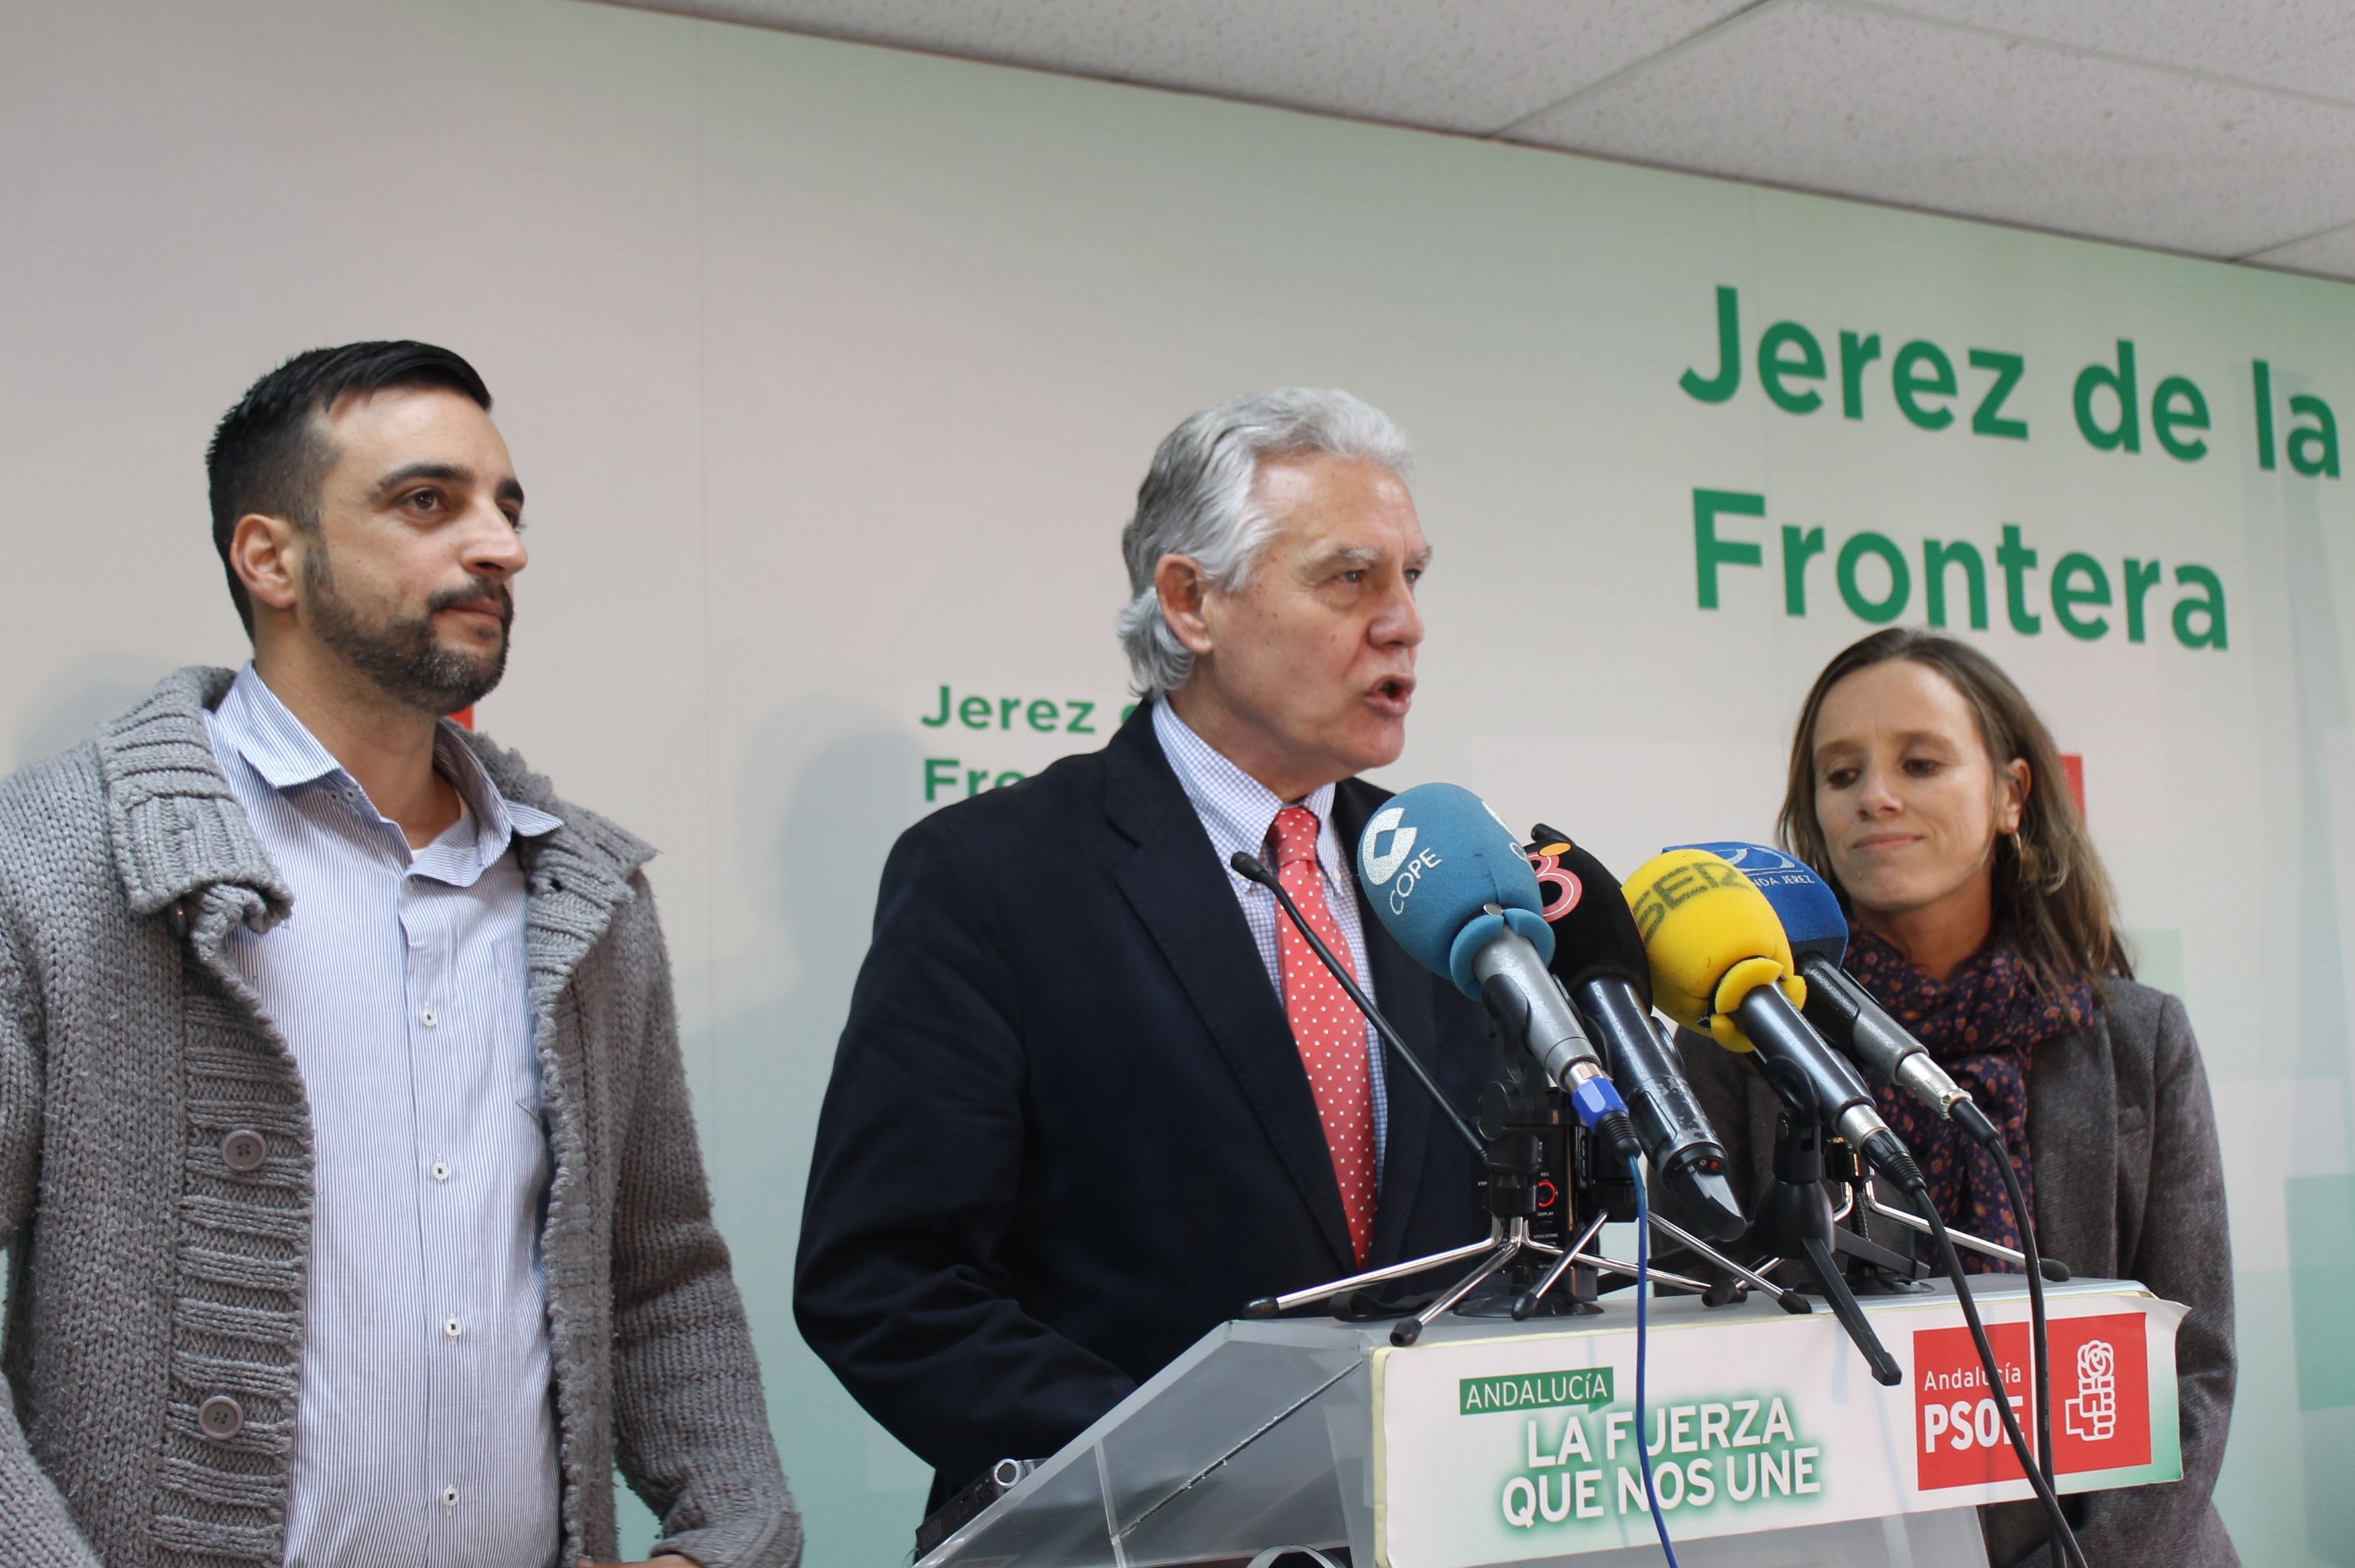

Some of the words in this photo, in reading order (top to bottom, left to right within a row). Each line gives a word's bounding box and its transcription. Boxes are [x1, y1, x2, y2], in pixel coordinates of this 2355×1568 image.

[1678, 285, 2029, 441] Jerez
[2073, 338, 2212, 462] de
[2252, 358, 2341, 479] la
[1692, 487, 2228, 651] Frontera
[920, 685, 1096, 734] Jerez
[1390, 847, 1443, 916] COPE
[1633, 861, 1753, 944] SER
[1782, 874, 1815, 885] JEREZ
[1528, 1416, 1592, 1468] LA
[1605, 1397, 1795, 1460] FUERZA
[1502, 1469, 1605, 1528] QUE
[1618, 1457, 1715, 1515] NOS
[1726, 1447, 1821, 1502] UNE
